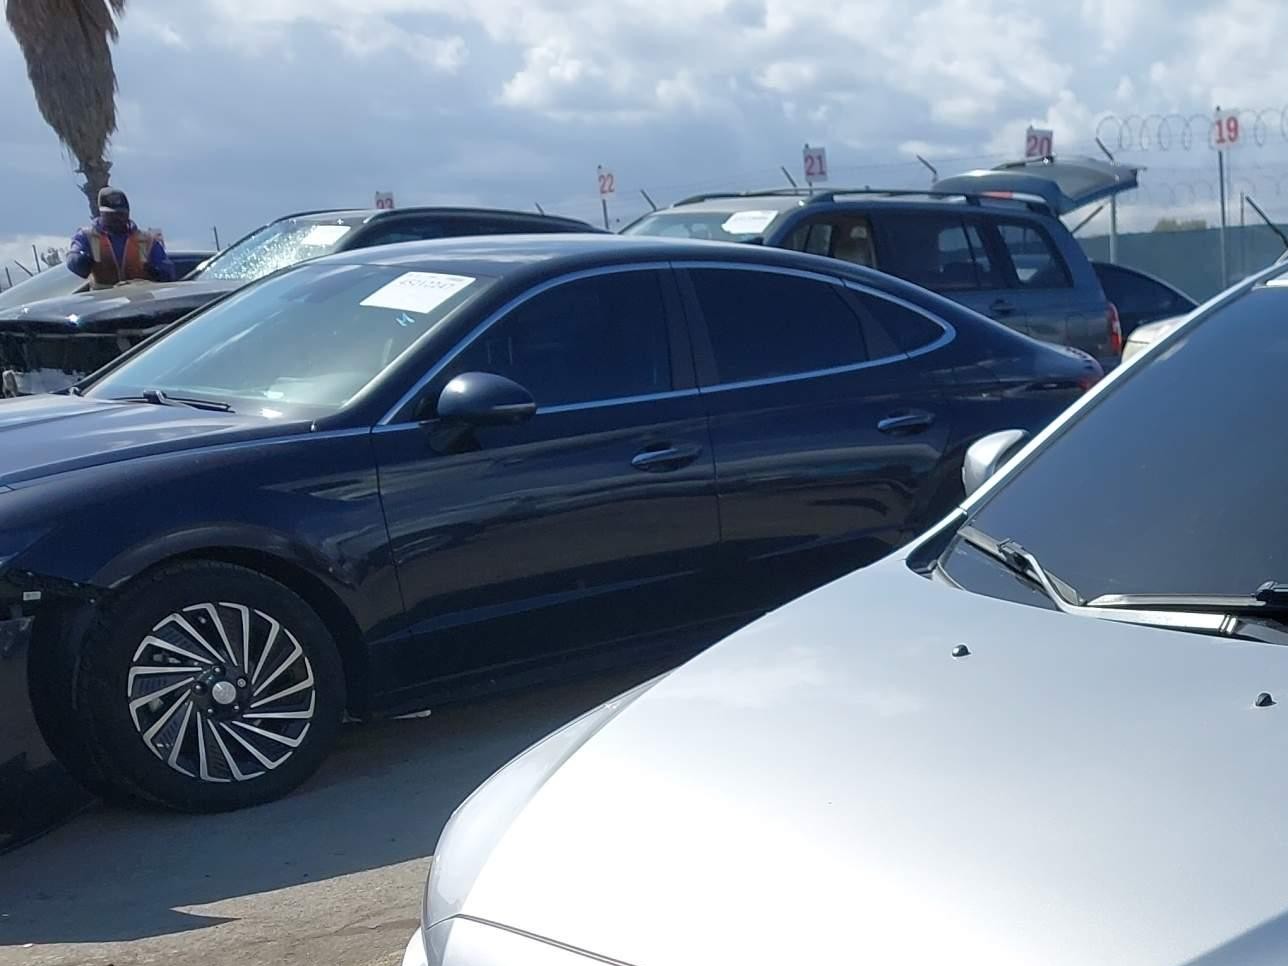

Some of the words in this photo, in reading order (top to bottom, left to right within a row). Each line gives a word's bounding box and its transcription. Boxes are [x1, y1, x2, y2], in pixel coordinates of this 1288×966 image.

[1215, 116, 1239, 144] 19
[1027, 135, 1052, 157] 20
[804, 154, 826, 176] 21
[598, 173, 615, 194] 22
